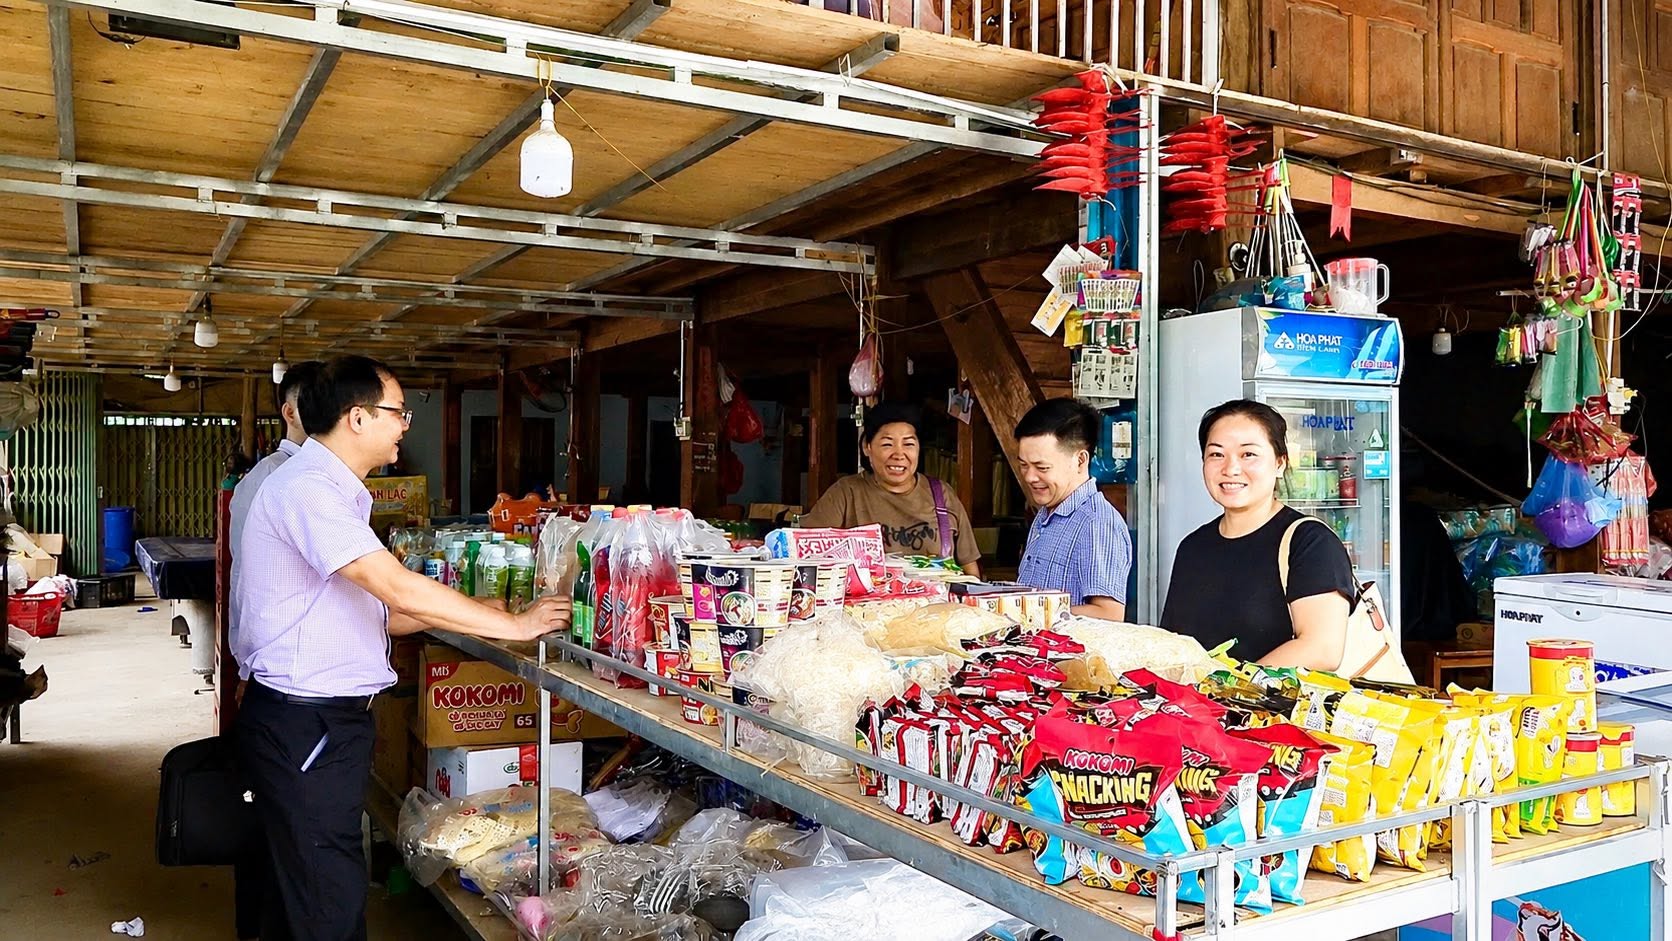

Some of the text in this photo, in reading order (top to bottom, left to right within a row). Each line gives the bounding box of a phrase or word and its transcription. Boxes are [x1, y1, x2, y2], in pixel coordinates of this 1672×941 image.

[1296, 333, 1343, 347] HOA PHAT
[433, 682, 526, 709] KOKOMI
[516, 715, 533, 727] 65
[1064, 749, 1135, 776] KOKOMI
